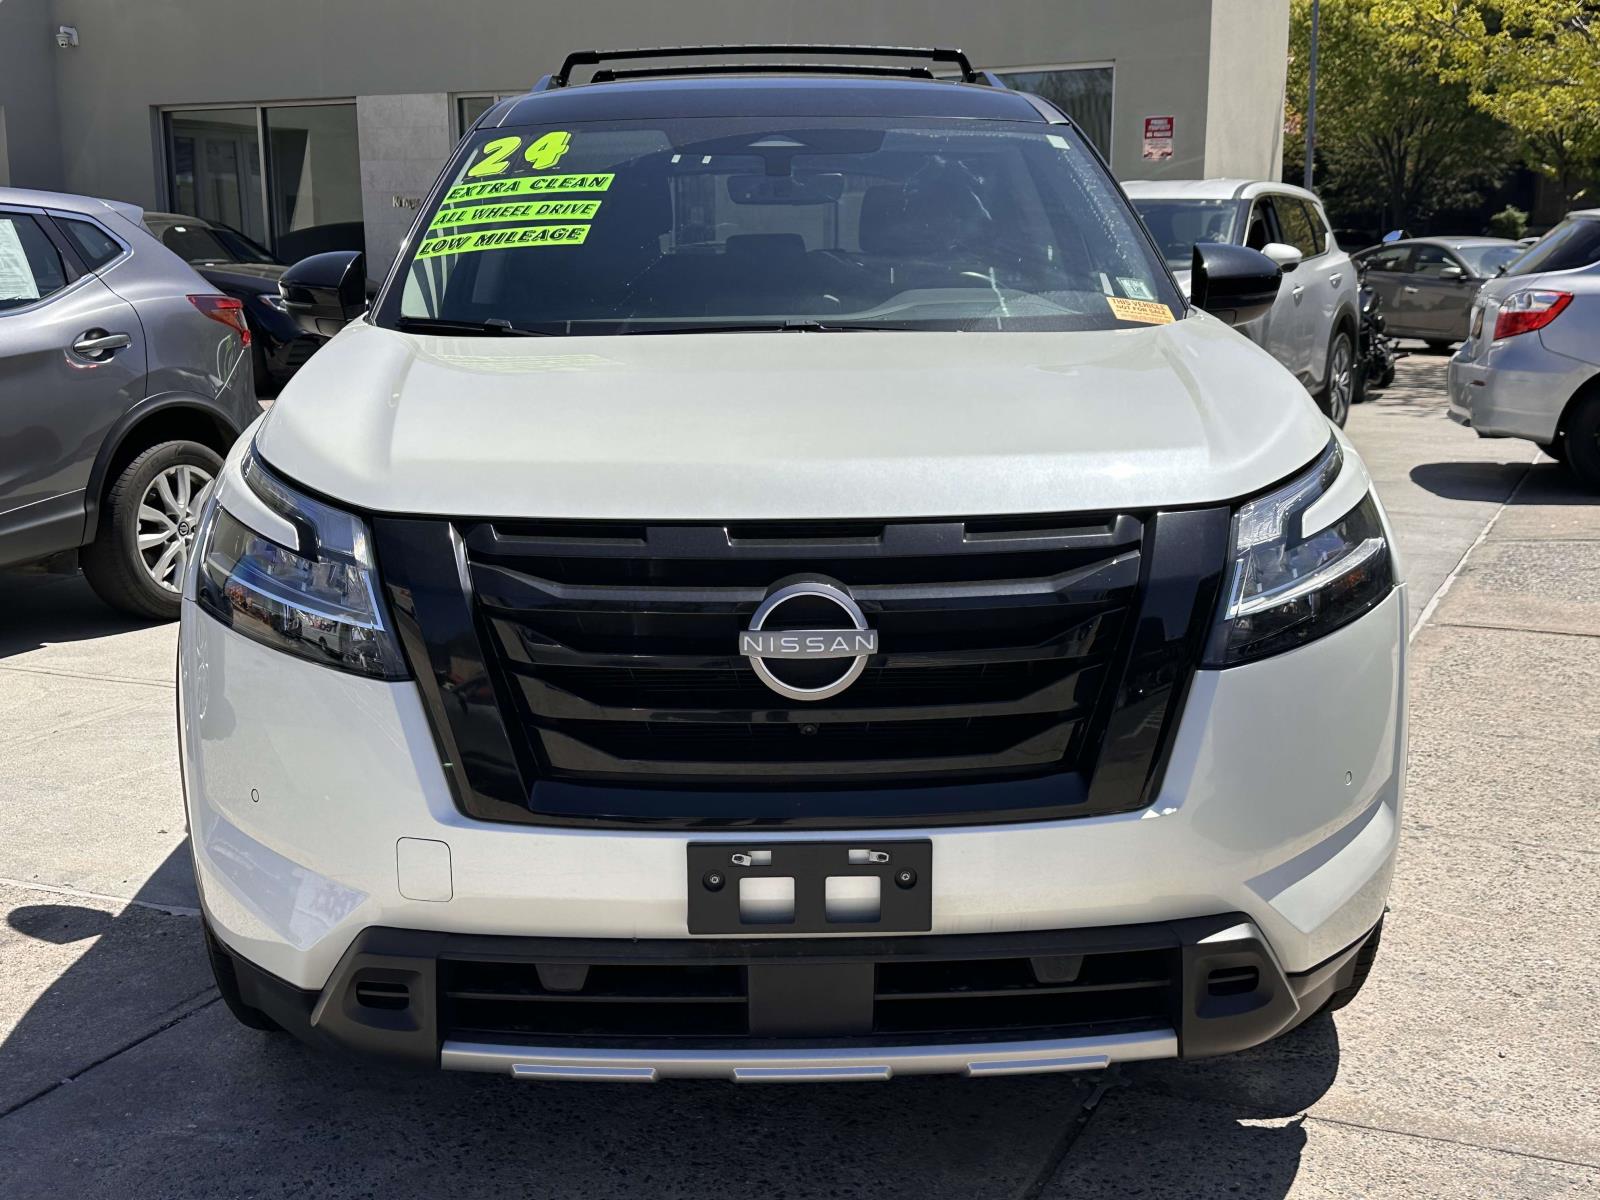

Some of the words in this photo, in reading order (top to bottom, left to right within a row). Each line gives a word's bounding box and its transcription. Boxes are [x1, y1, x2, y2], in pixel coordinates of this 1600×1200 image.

[467, 131, 572, 177] 24
[448, 180, 520, 200] EXTRA
[529, 176, 609, 191] CLEAN
[432, 210, 467, 226] ALL
[471, 205, 530, 220] WHEEL
[534, 203, 597, 216] DRIVE
[418, 236, 471, 256] LOW
[474, 227, 586, 247] MILEAGE
[743, 634, 874, 653] NISSAN
